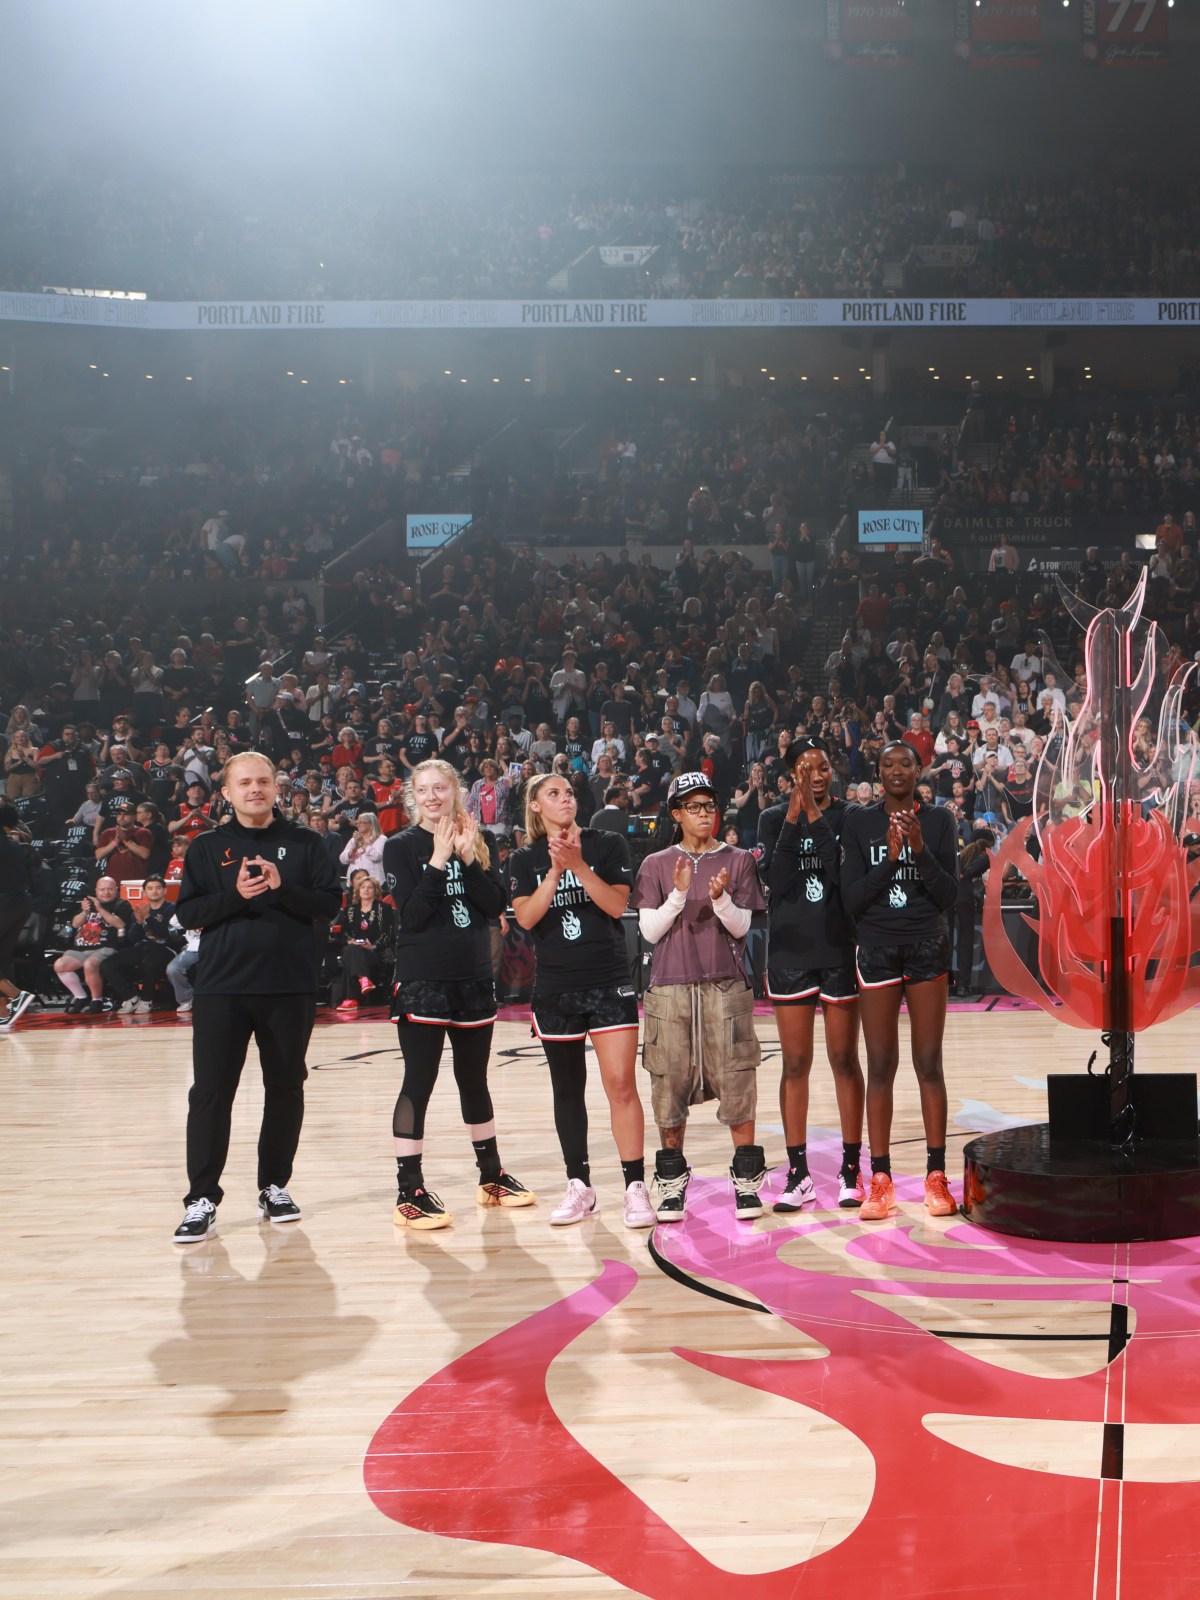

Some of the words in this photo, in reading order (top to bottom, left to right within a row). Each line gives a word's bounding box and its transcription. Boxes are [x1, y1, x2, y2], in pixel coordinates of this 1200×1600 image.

[1104, 0, 1156, 32] 77
[1, 296, 98, 321] PORTLAND
[104, 302, 148, 324] FIRE
[197, 305, 281, 325] PORTLAND
[287, 305, 325, 324] FIRE
[370, 304, 454, 323] PORTLAND
[458, 304, 498, 323] FIRE
[521, 303, 604, 323] PORTLAND
[610, 303, 648, 323] FIRE
[691, 303, 774, 322] PORTLAND
[780, 303, 818, 322] FIRE
[841, 302, 924, 321] PORTLAND
[929, 302, 967, 321] FIRE
[1009, 302, 1092, 321] PORTLAND
[1097, 302, 1135, 321] FIRE
[410, 522, 440, 539] ROSE
[863, 518, 889, 535] ROSE
[893, 518, 920, 535] CITY
[943, 517, 1015, 529] DAIMLER
[1024, 516, 1073, 528] TRUCK
[68, 826, 87, 837] FIRE
